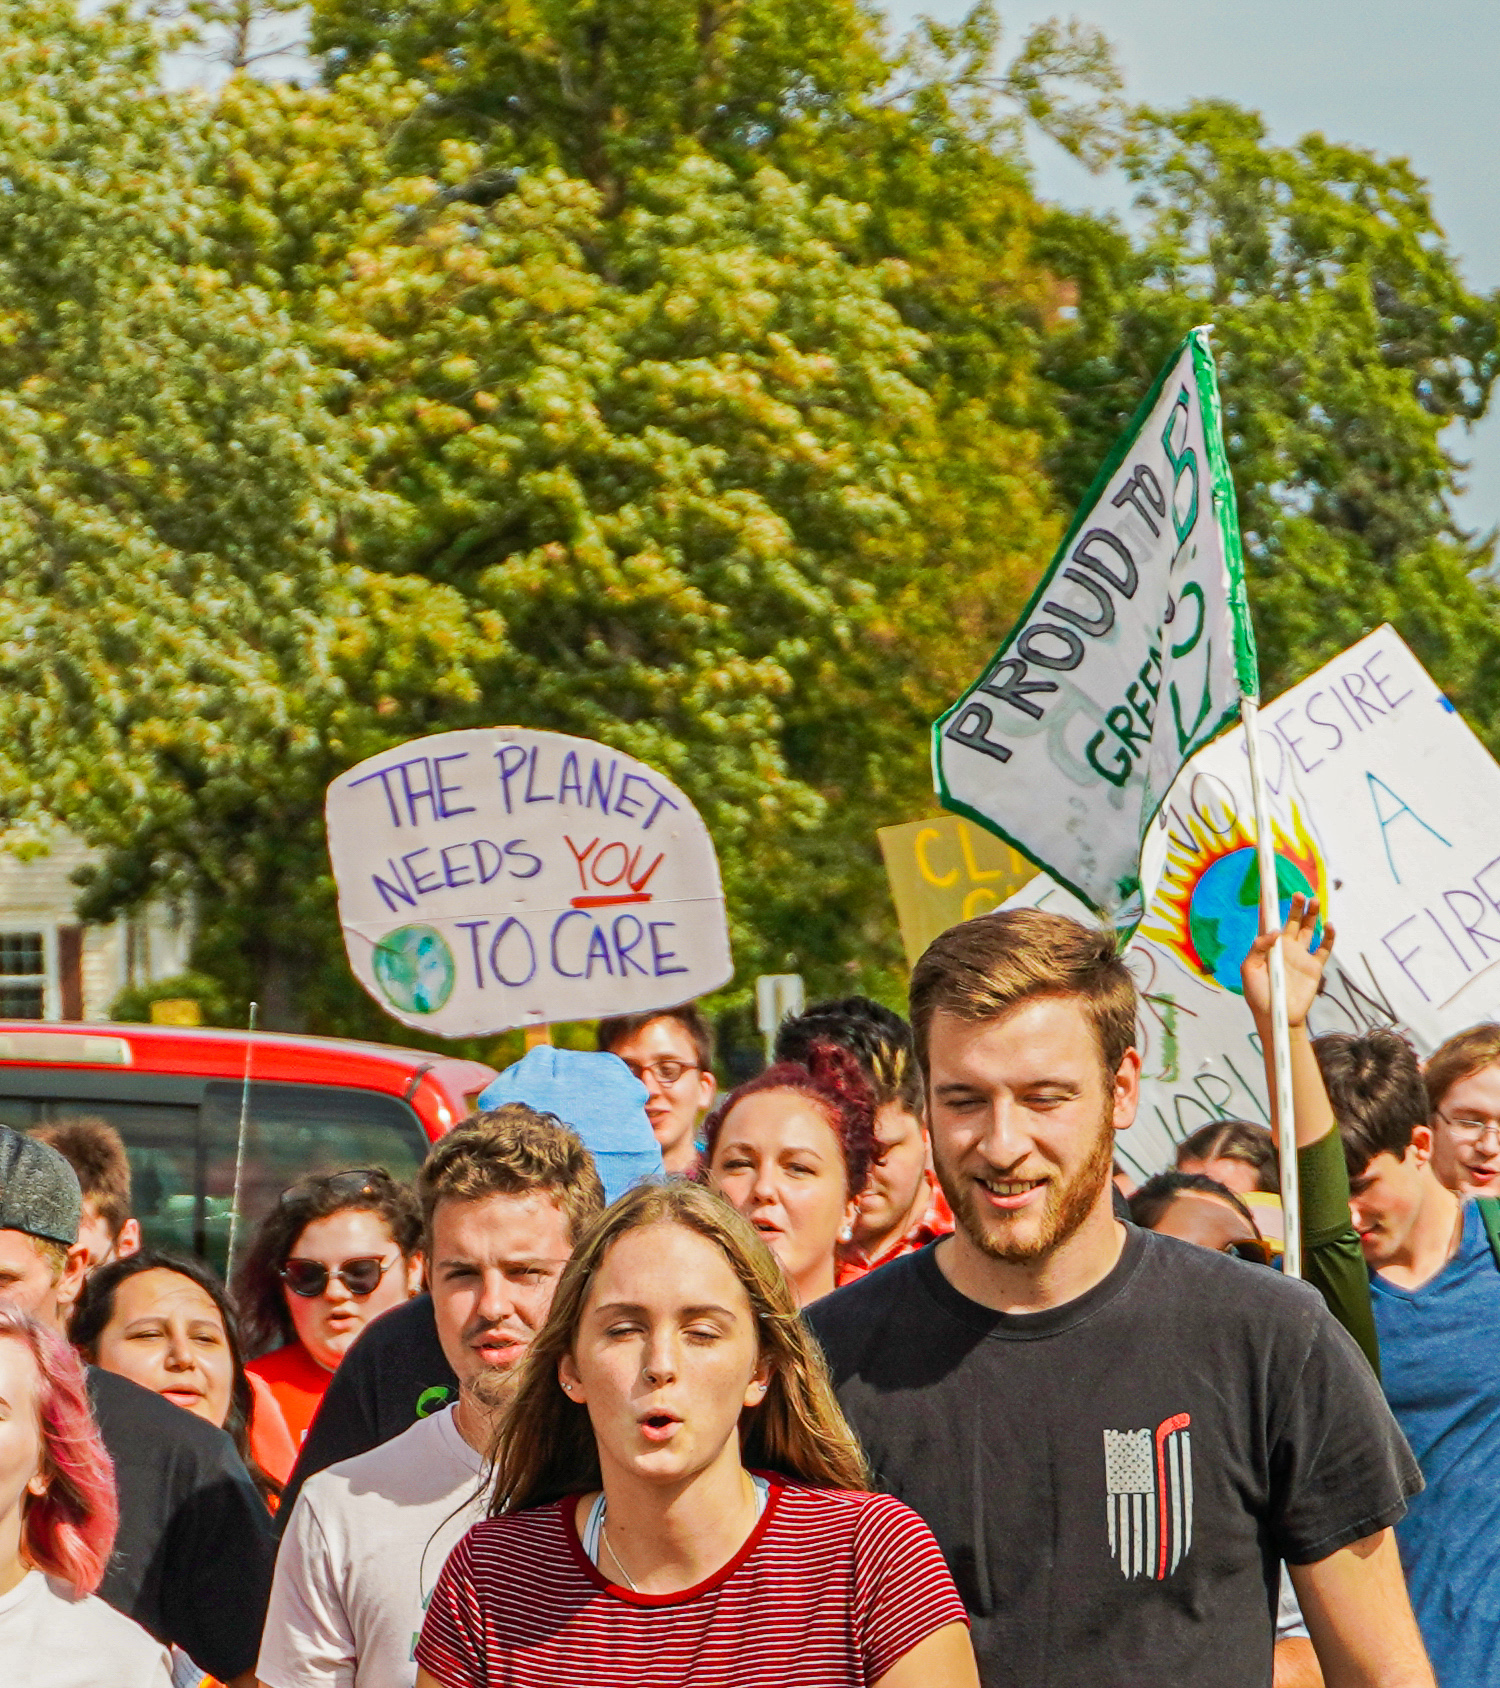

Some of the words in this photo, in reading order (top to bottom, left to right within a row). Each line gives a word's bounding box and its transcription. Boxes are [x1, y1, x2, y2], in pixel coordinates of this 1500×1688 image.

[944, 528, 1140, 764] PROUD
[347, 752, 476, 827] THE
[492, 745, 681, 829] PLANET
[1366, 771, 1453, 885] A
[371, 839, 543, 913] NEEDS
[563, 835, 665, 893] YOU
[454, 916, 538, 989] TO
[550, 910, 689, 980] CARE
